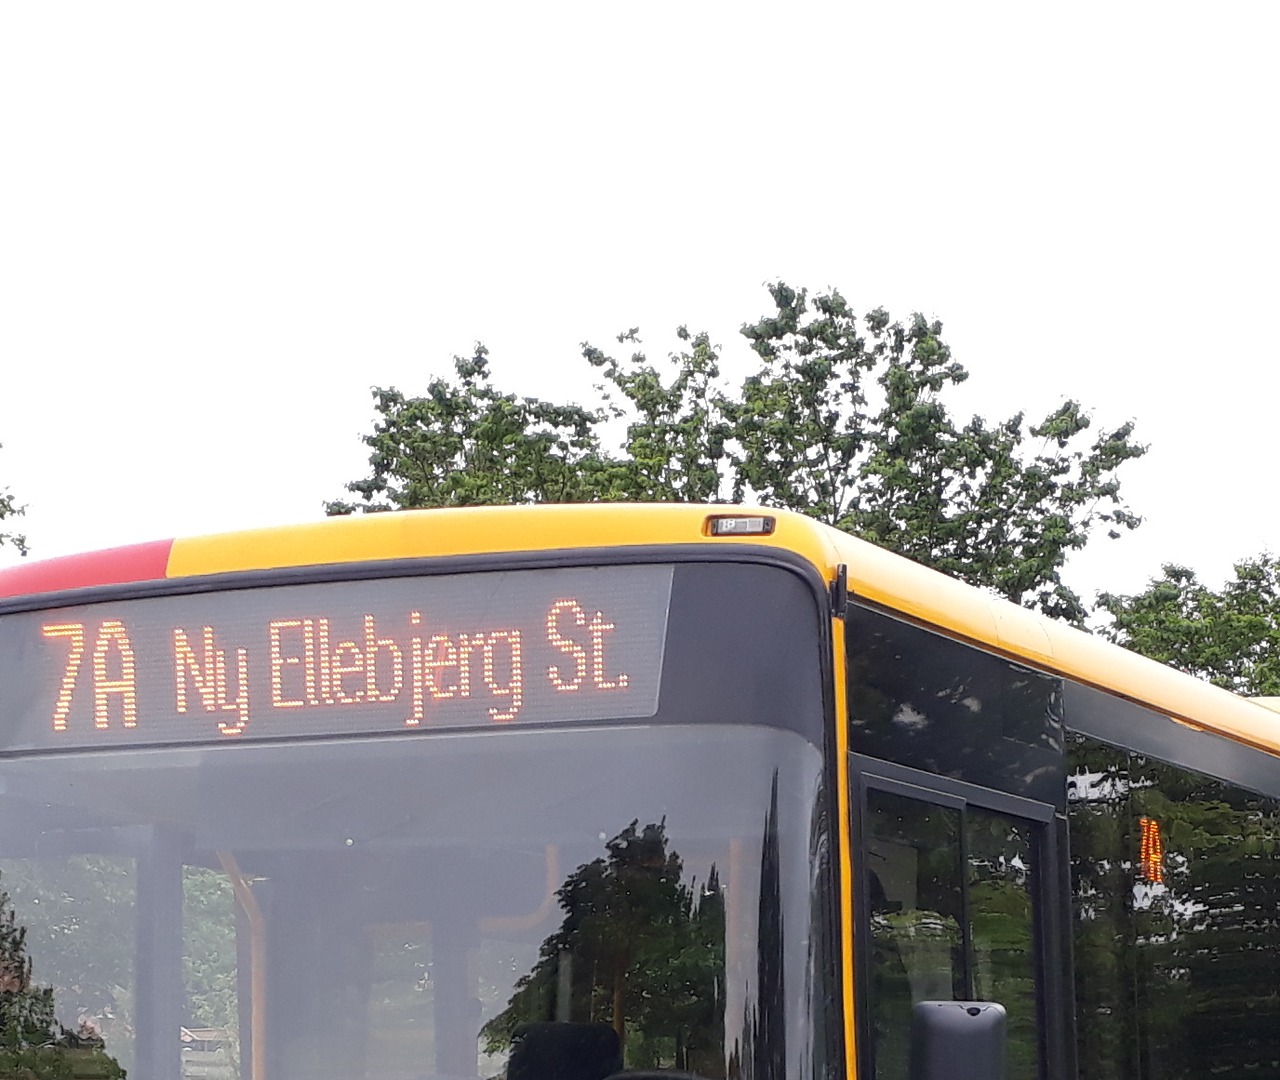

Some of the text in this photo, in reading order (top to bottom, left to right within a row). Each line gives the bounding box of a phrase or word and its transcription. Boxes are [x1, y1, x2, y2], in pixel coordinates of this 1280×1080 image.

[42, 599, 629, 735] 7A Ny Ellebjerg St.
